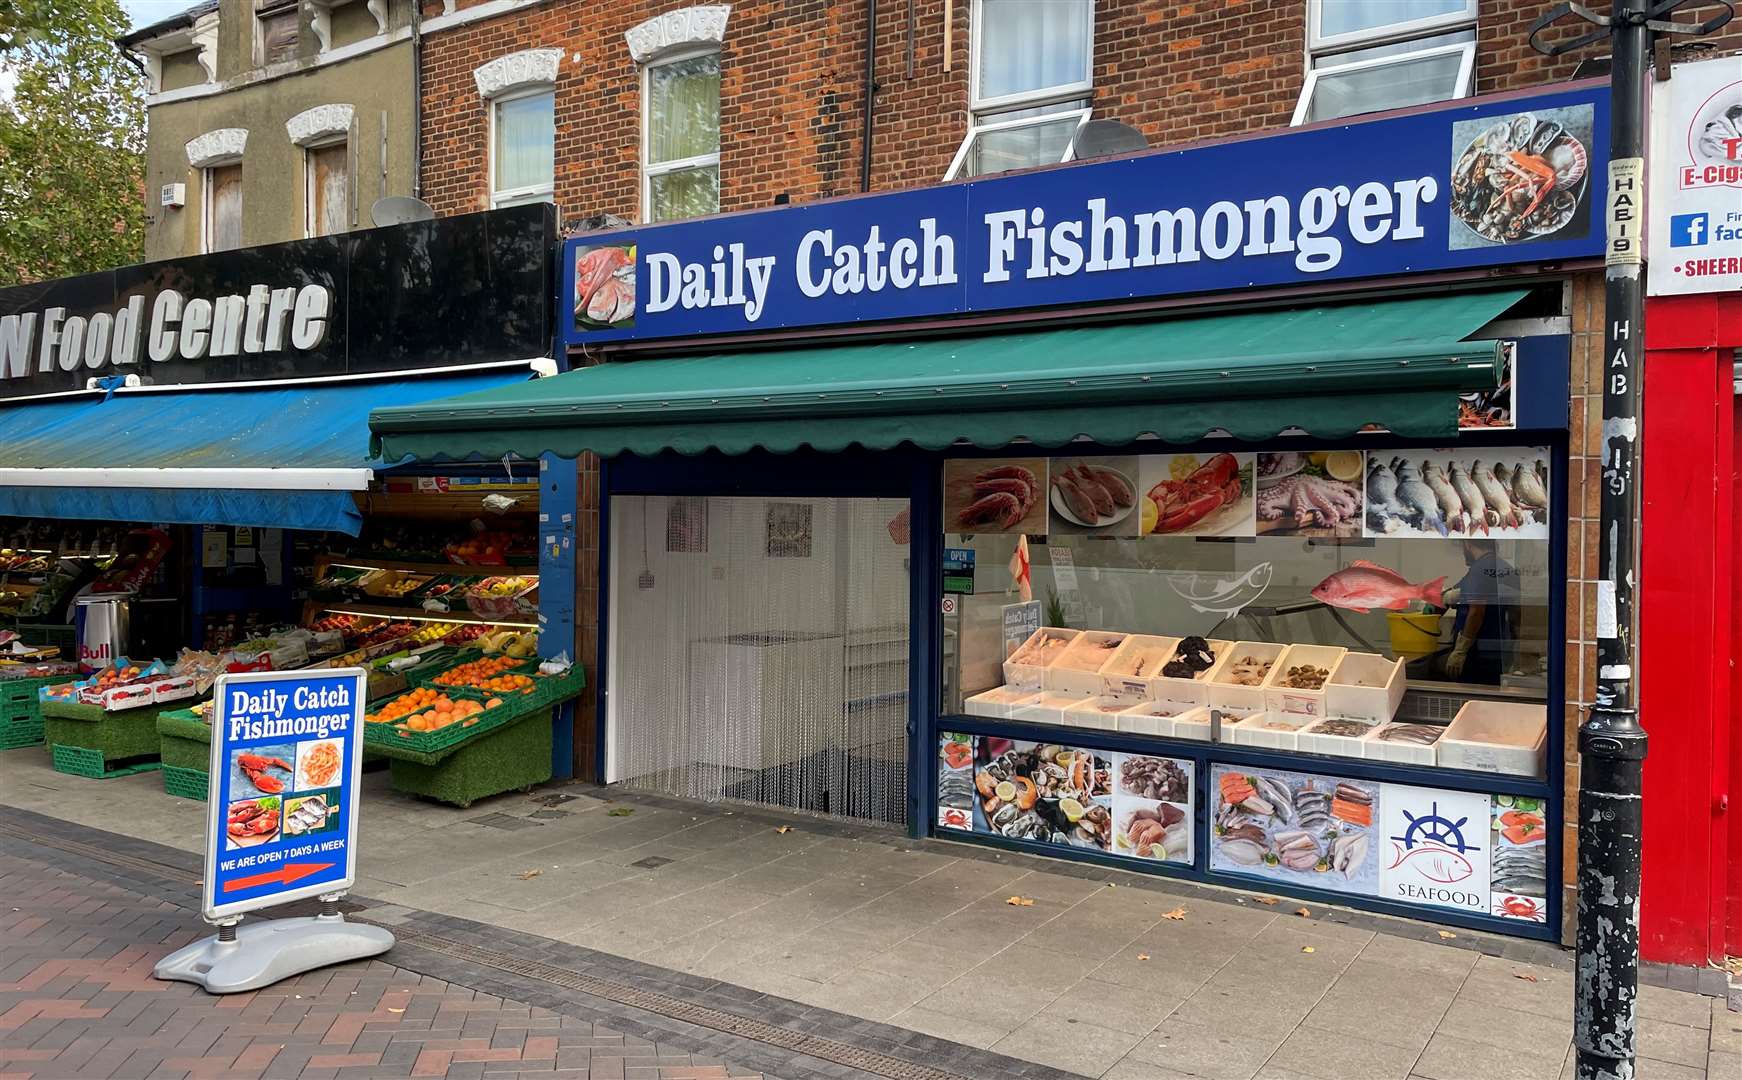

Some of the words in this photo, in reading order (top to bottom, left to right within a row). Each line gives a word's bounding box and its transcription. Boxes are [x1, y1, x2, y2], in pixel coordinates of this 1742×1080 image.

[645, 242, 775, 322] Daily
[796, 217, 958, 298] Catch
[983, 175, 1438, 284] Fishmonger
[1685, 256, 1742, 277] SHEER
[38, 294, 146, 373] Food
[148, 283, 331, 362] Centre
[79, 643, 109, 659] Bull
[231, 688, 288, 718] Daily
[293, 684, 350, 711] Catch
[228, 712, 350, 742] Fishmonger
[220, 860, 236, 872] WE
[236, 856, 256, 868] ARE
[257, 852, 282, 865] OPEN
[283, 848, 290, 860] 7
[290, 845, 312, 858] DAYS
[313, 843, 320, 854] A
[320, 838, 345, 852] WEEK
